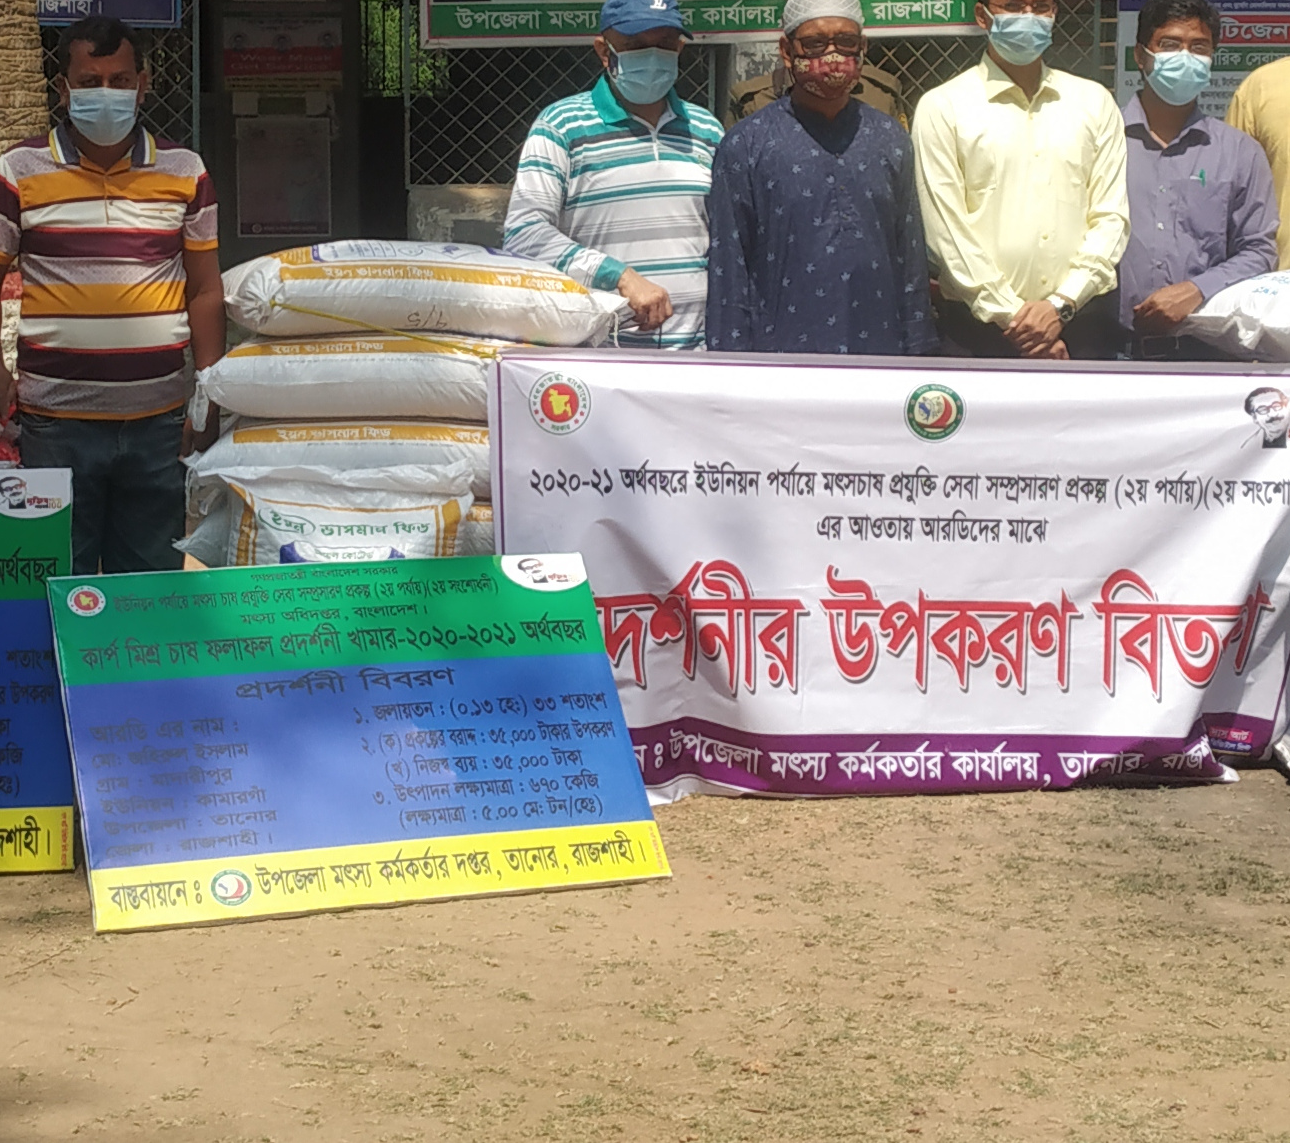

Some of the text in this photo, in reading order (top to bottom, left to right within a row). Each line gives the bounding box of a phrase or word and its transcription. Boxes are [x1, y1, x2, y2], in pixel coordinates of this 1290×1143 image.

[453, 2, 600, 29] উপজেলা মৎস্য
[529, 467, 613, 497] ২০২০-২১
[618, 464, 689, 497] অর্থবছরে
[692, 464, 761, 496] ইউনিয়ন
[765, 465, 818, 496] পর্যায়ে
[820, 470, 886, 497] মৎসচাষ
[888, 465, 939, 504] প্রযুক্তি
[942, 473, 981, 500] সেবা
[979, 474, 1062, 504] সম্প্রসারণ
[1064, 474, 1110, 504] প্রকল্প
[816, 511, 1049, 543] এর আওতায় আরডিদের মাঝে
[819, 563, 1082, 690] উপকরণ
[667, 730, 763, 778] উপজেলা
[769, 748, 829, 781] মৎস্য
[835, 740, 947, 780] কর্মকর্তার
